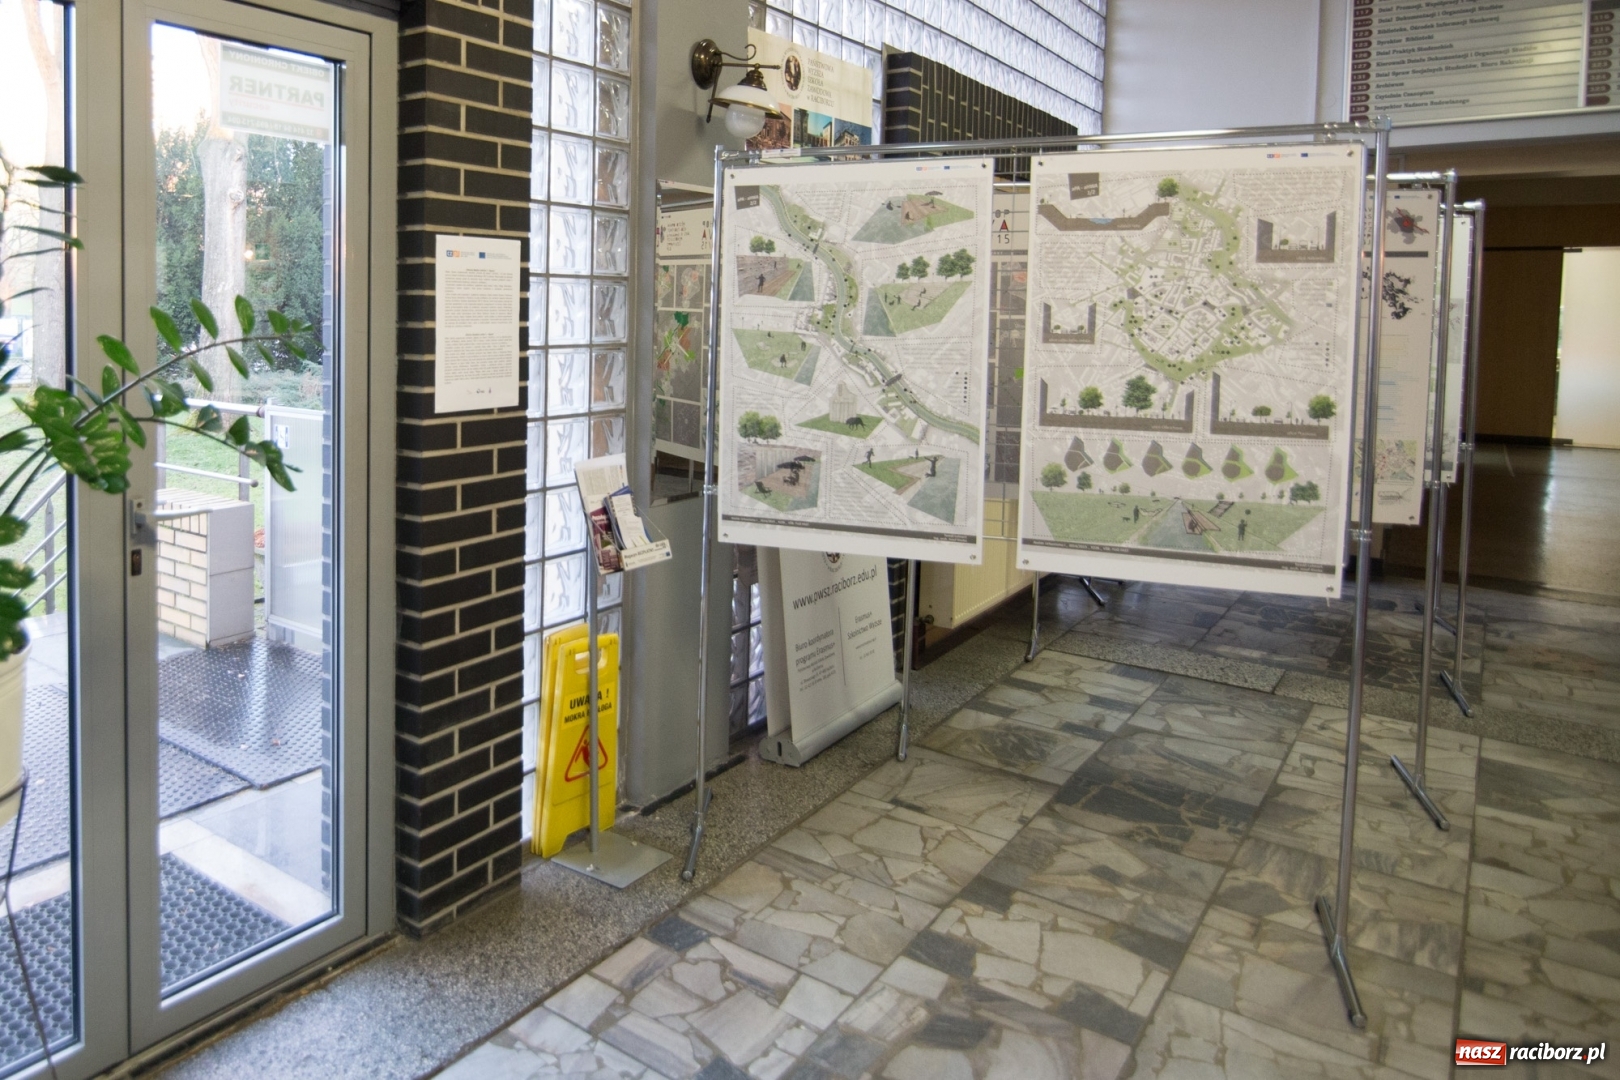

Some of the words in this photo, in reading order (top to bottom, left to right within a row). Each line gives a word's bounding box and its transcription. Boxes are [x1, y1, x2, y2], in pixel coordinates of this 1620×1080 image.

[793, 564, 878, 610] www.pwsz.raciborz.edu.pl
[569, 690, 602, 710] UWAA
[564, 710, 585, 724] MOKRA
